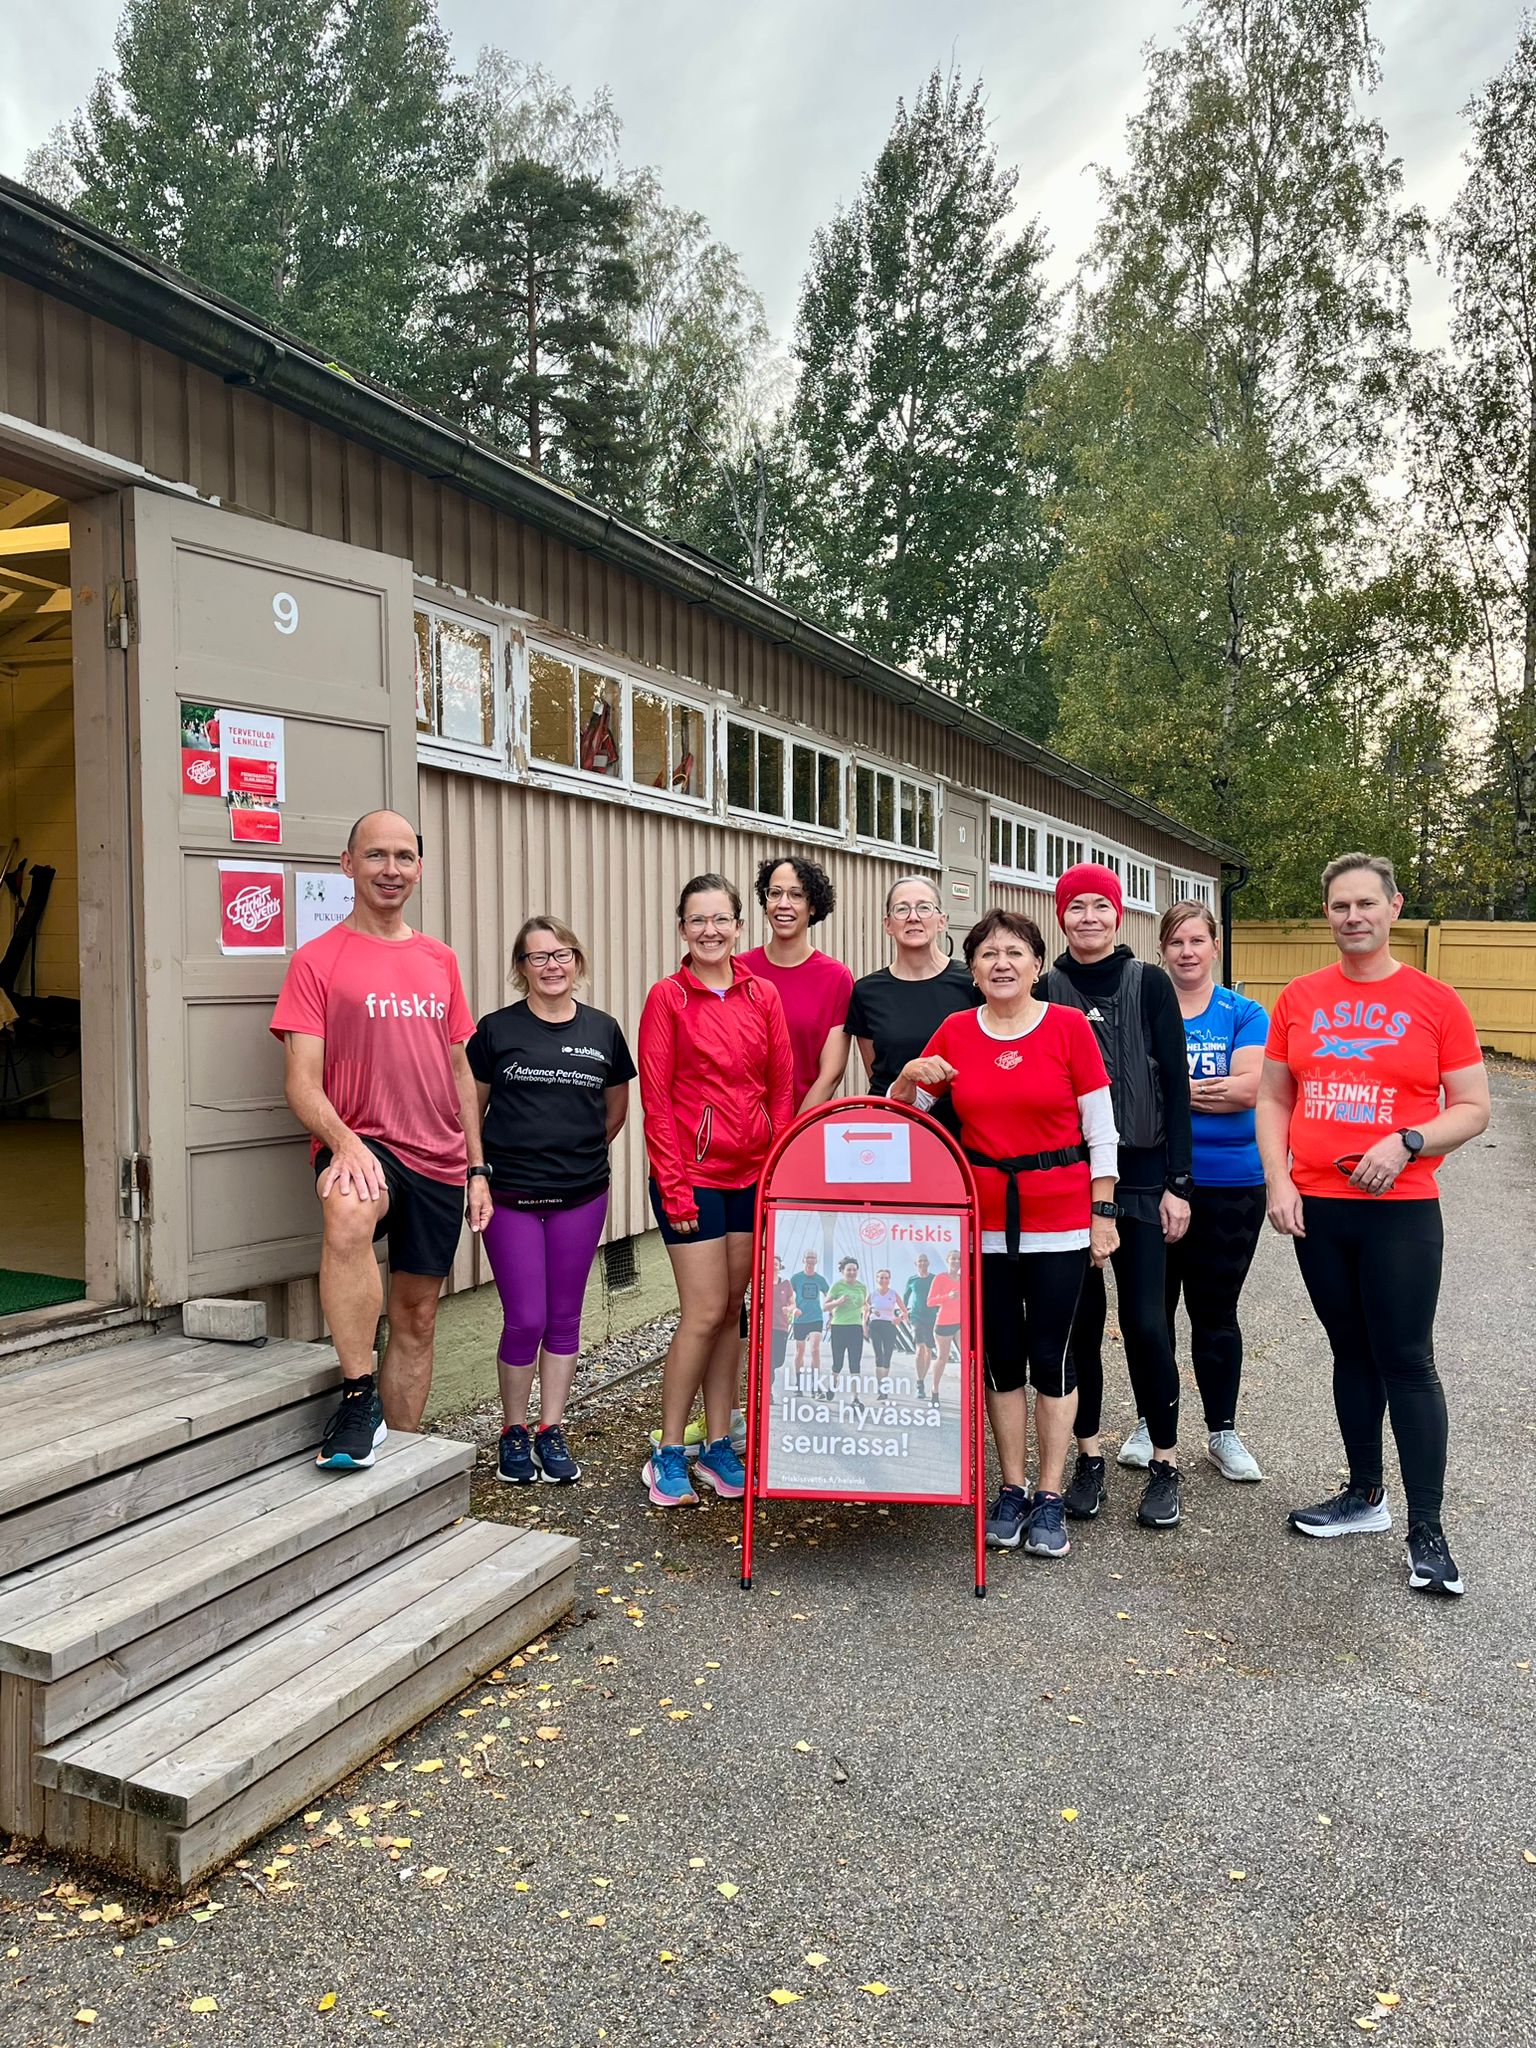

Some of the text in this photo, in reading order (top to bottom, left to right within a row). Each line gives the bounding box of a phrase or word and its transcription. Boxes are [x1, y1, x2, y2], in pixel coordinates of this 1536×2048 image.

[271, 591, 299, 635] 9
[228, 726, 276, 740] TERVETULOA
[959, 826, 965, 843] 10
[365, 992, 445, 1020] friskis
[1310, 1000, 1411, 1037] ASICS
[1186, 1043, 1226, 1051] HELSINKI
[513, 1074, 556, 1084] Peterborough
[557, 1077, 573, 1085] New
[573, 1078, 587, 1087] Years
[515, 1067, 555, 1077] Advance
[1303, 1080, 1380, 1104] HELSINKI
[1377, 1087, 1398, 1125] 2014
[891, 1224, 952, 1242] friskis
[784, 1367, 911, 1395] Liikunnan
[782, 1396, 941, 1431] iloa hyvässä
[781, 1433, 908, 1457] seurassa!
